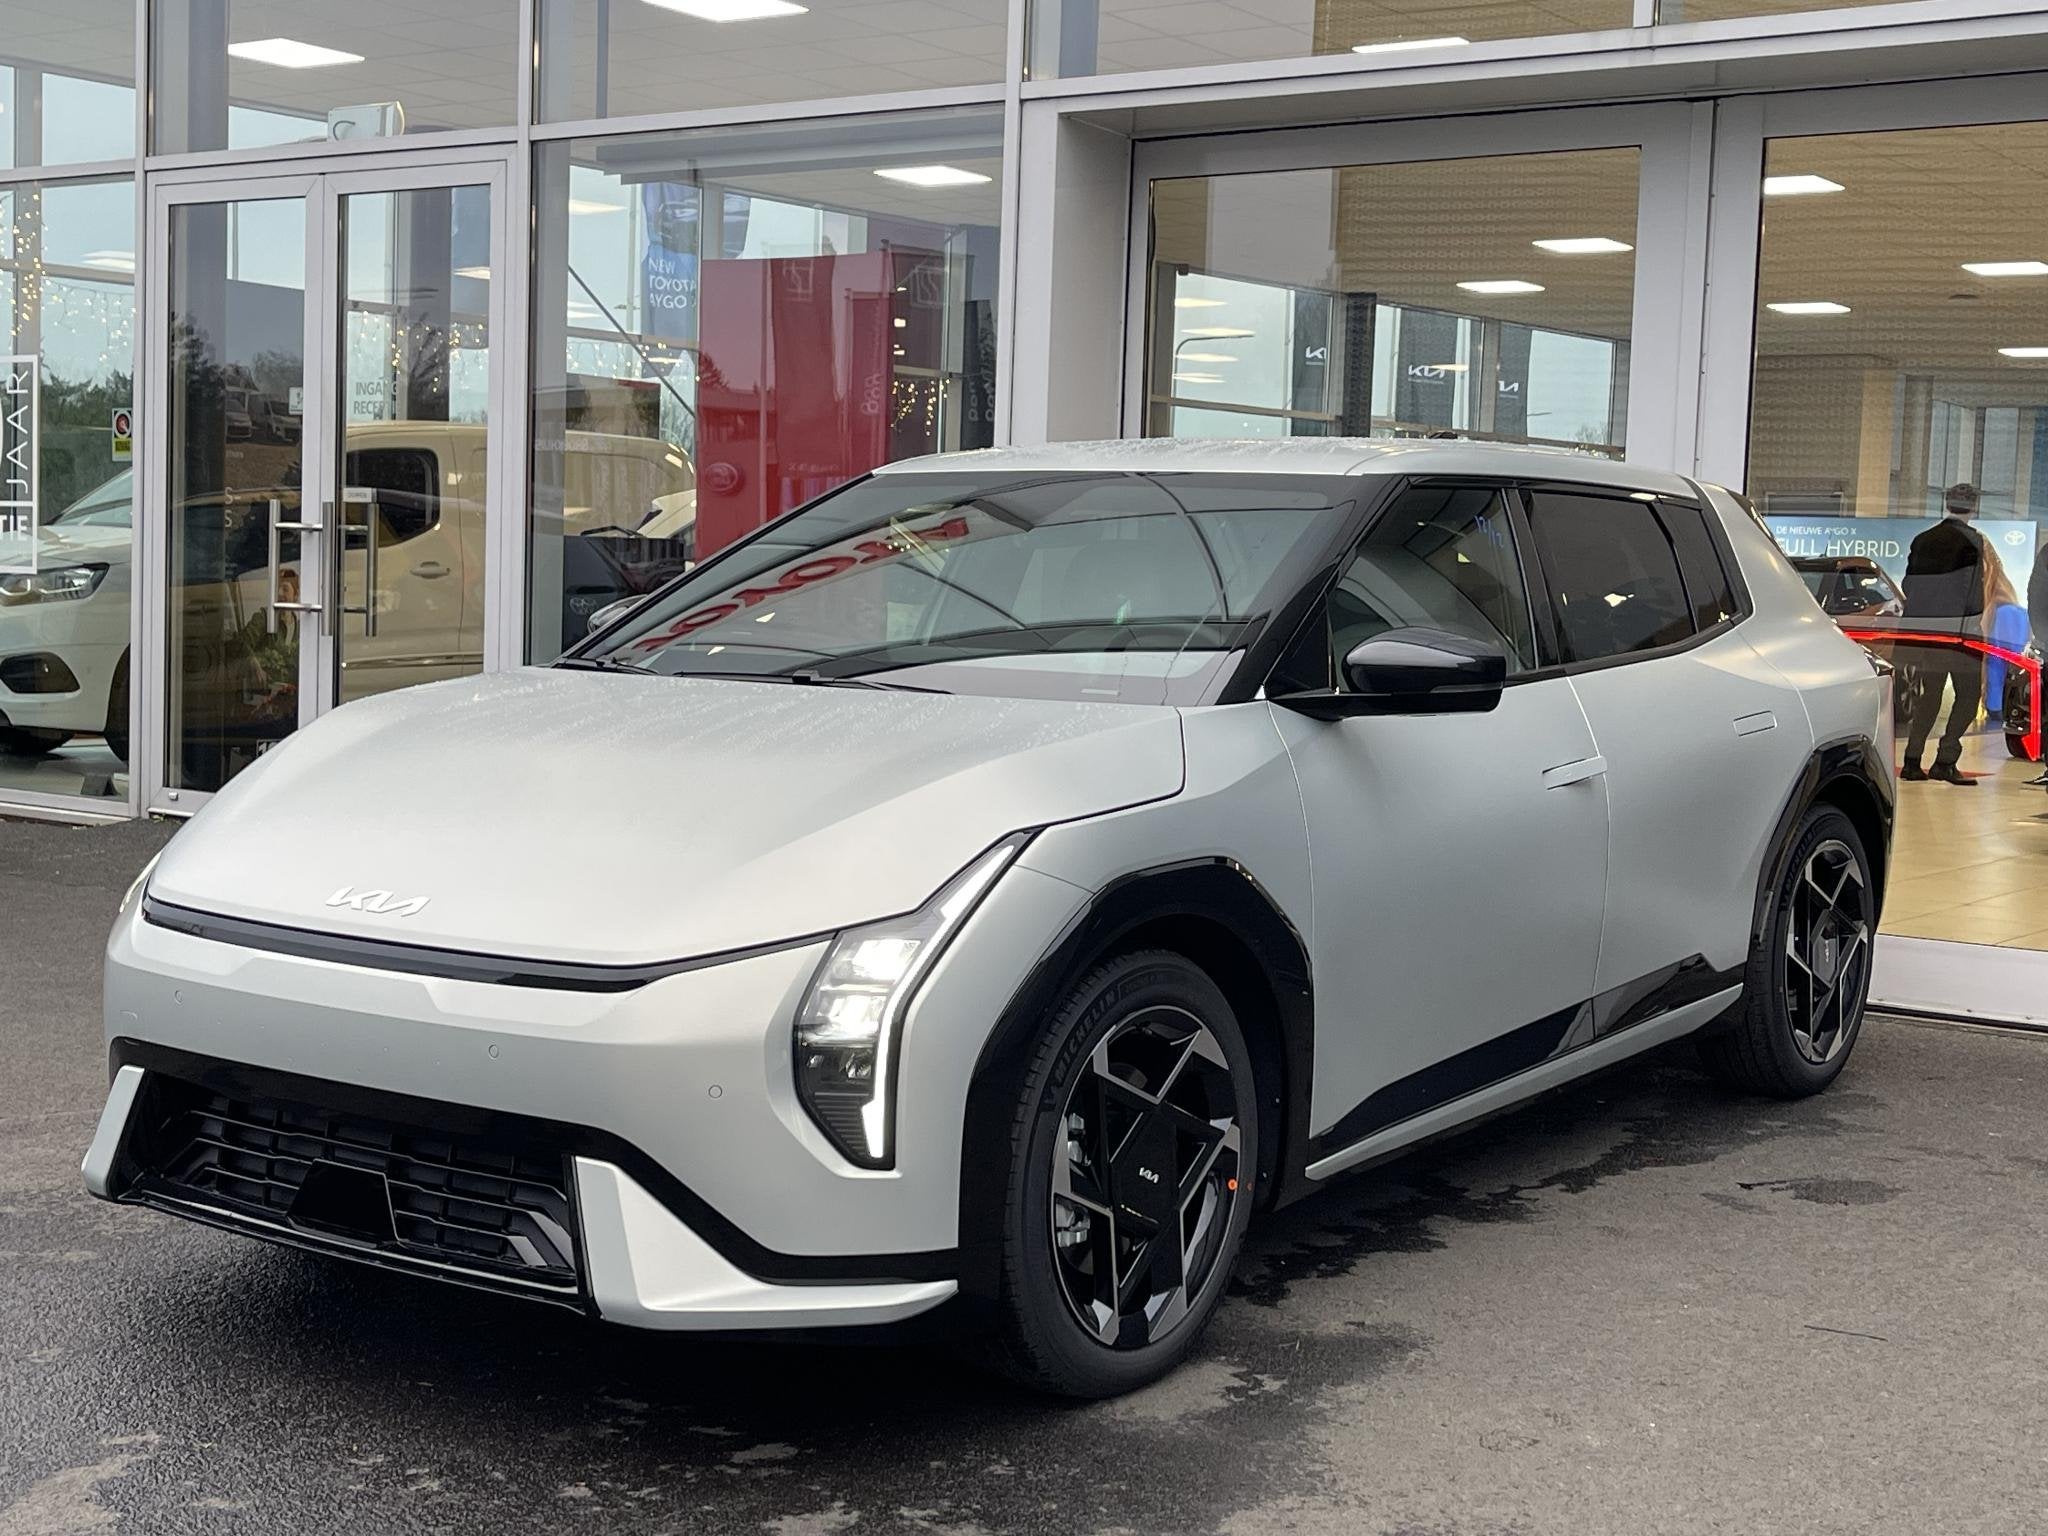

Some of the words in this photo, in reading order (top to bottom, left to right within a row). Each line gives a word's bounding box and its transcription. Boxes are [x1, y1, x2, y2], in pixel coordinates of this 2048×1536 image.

[648, 257, 676, 274] NEW
[649, 293, 687, 309] AYGO
[6, 370, 29, 494] JAAR
[1776, 526, 1788, 534] DE
[1790, 526, 1822, 535] NIEUWE
[1827, 539, 1904, 558] HYBRID.
[325, 886, 431, 918] KIA
[1053, 989, 1116, 1084] MICHELIN
[1139, 1166, 1159, 1183] KIA
